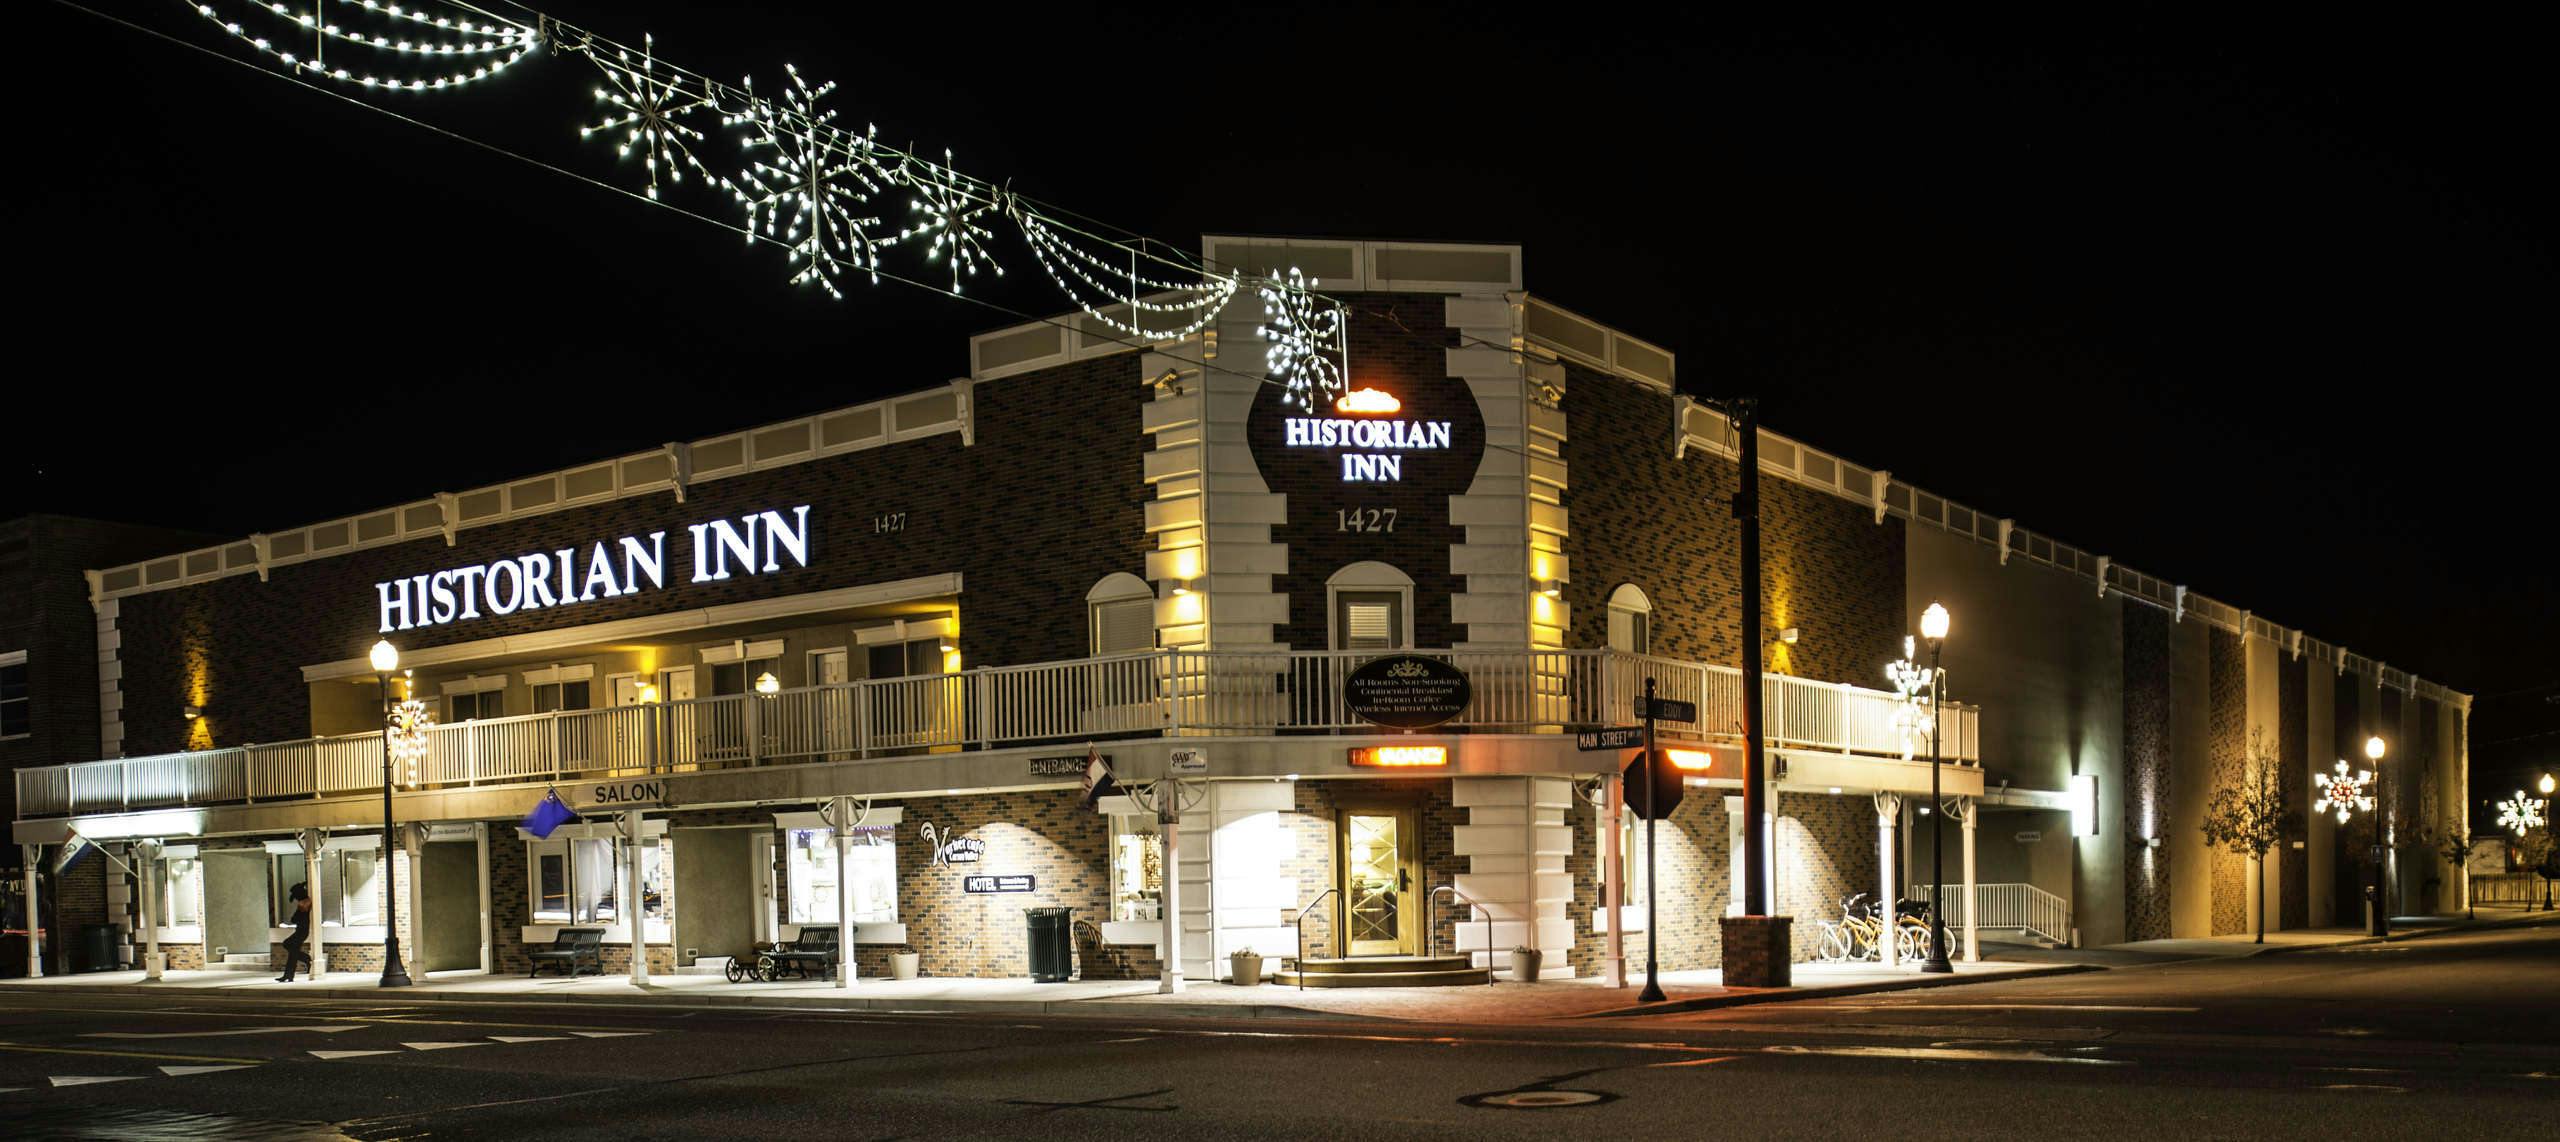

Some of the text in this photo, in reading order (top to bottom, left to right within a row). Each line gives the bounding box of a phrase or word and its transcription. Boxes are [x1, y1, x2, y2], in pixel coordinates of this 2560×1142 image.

[1285, 418, 1451, 449] HISTORIAN
[1343, 454, 1401, 482] INN
[873, 512, 907, 534] 1427
[1336, 508, 1398, 533] 1427
[375, 504, 811, 634] HISTORIAN INN
[1361, 687, 1410, 695] Continental
[1367, 679, 1399, 687] Rooms
[1431, 704, 1460, 712] Access
[1579, 732, 1598, 748] MAIN
[1601, 730, 1627, 746] STREET
[595, 783, 659, 803] SALON
[969, 877, 996, 891] HOTEL
